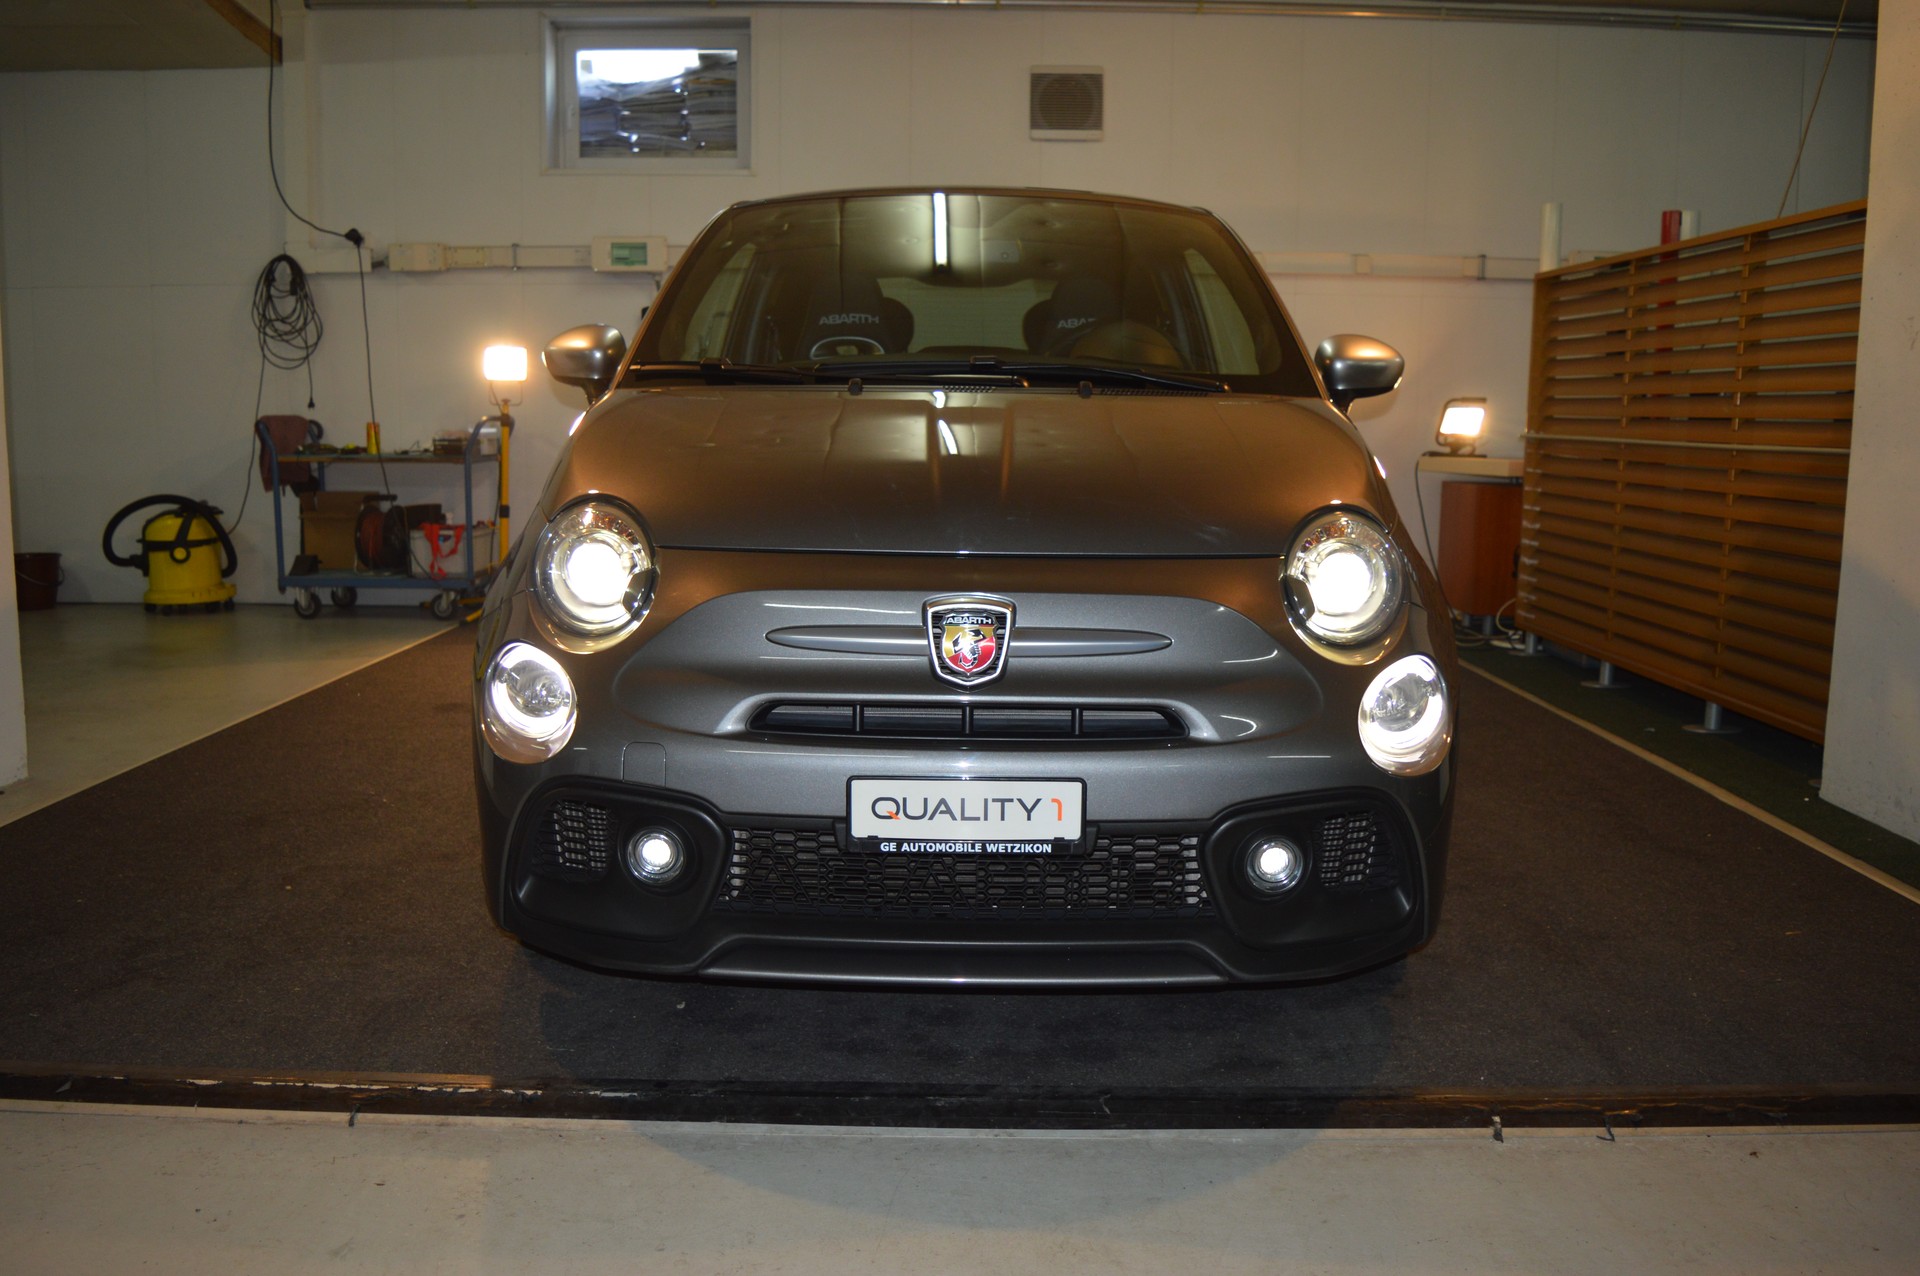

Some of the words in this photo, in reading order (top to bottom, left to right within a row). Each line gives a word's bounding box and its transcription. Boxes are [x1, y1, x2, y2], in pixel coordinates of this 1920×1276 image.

[819, 313, 879, 325] ABARTH
[946, 616, 992, 624] ABARTH
[880, 842, 897, 852] GE
[901, 842, 982, 853] AUTOMOBILE
[986, 843, 1052, 853] WETZIKON
